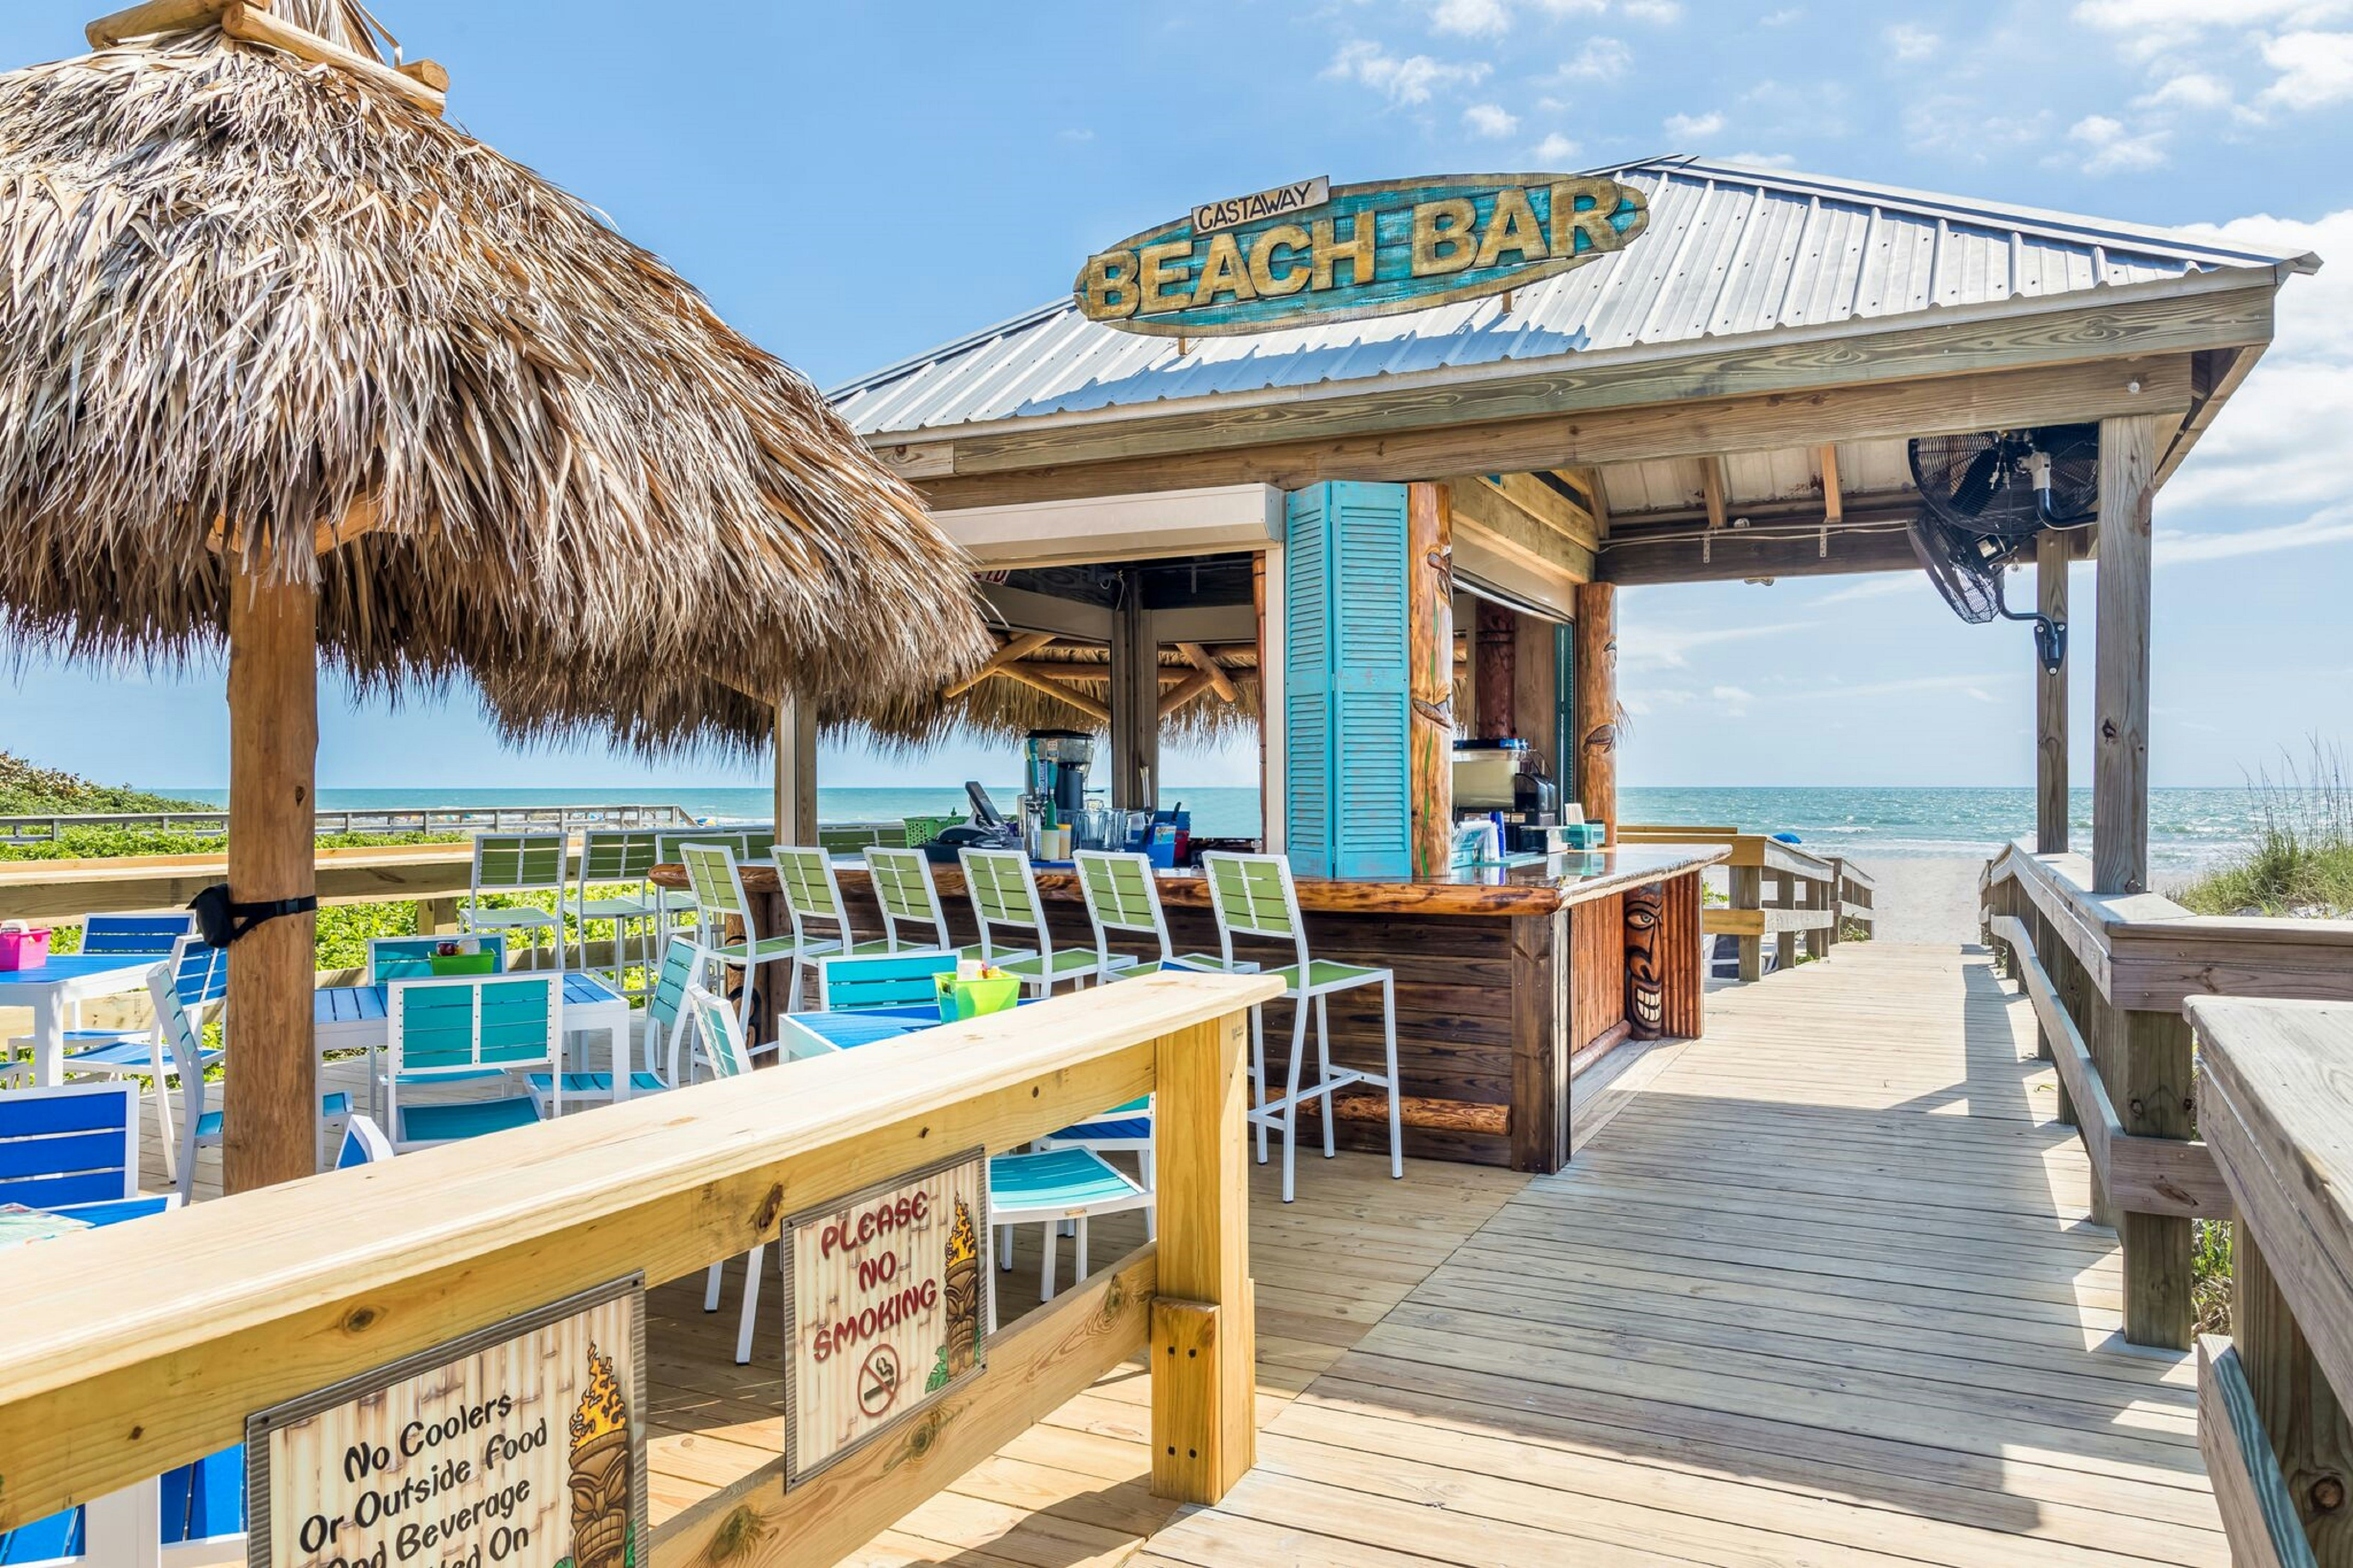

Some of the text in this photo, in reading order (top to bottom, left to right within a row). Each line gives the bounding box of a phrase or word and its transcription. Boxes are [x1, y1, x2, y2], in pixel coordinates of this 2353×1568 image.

[1198, 182, 1312, 230] CASTAWAY
[1088, 176, 1625, 320] BEACH BAR
[821, 1191, 929, 1259] PLEASE
[858, 1251, 897, 1292] NO
[813, 1278, 937, 1362] SMOKING
[344, 1394, 512, 1483] No Coolers
[300, 1514, 344, 1553] Or
[354, 1459, 470, 1528] Outside
[395, 1479, 530, 1562] Beverage
[489, 1526, 529, 1562] On
